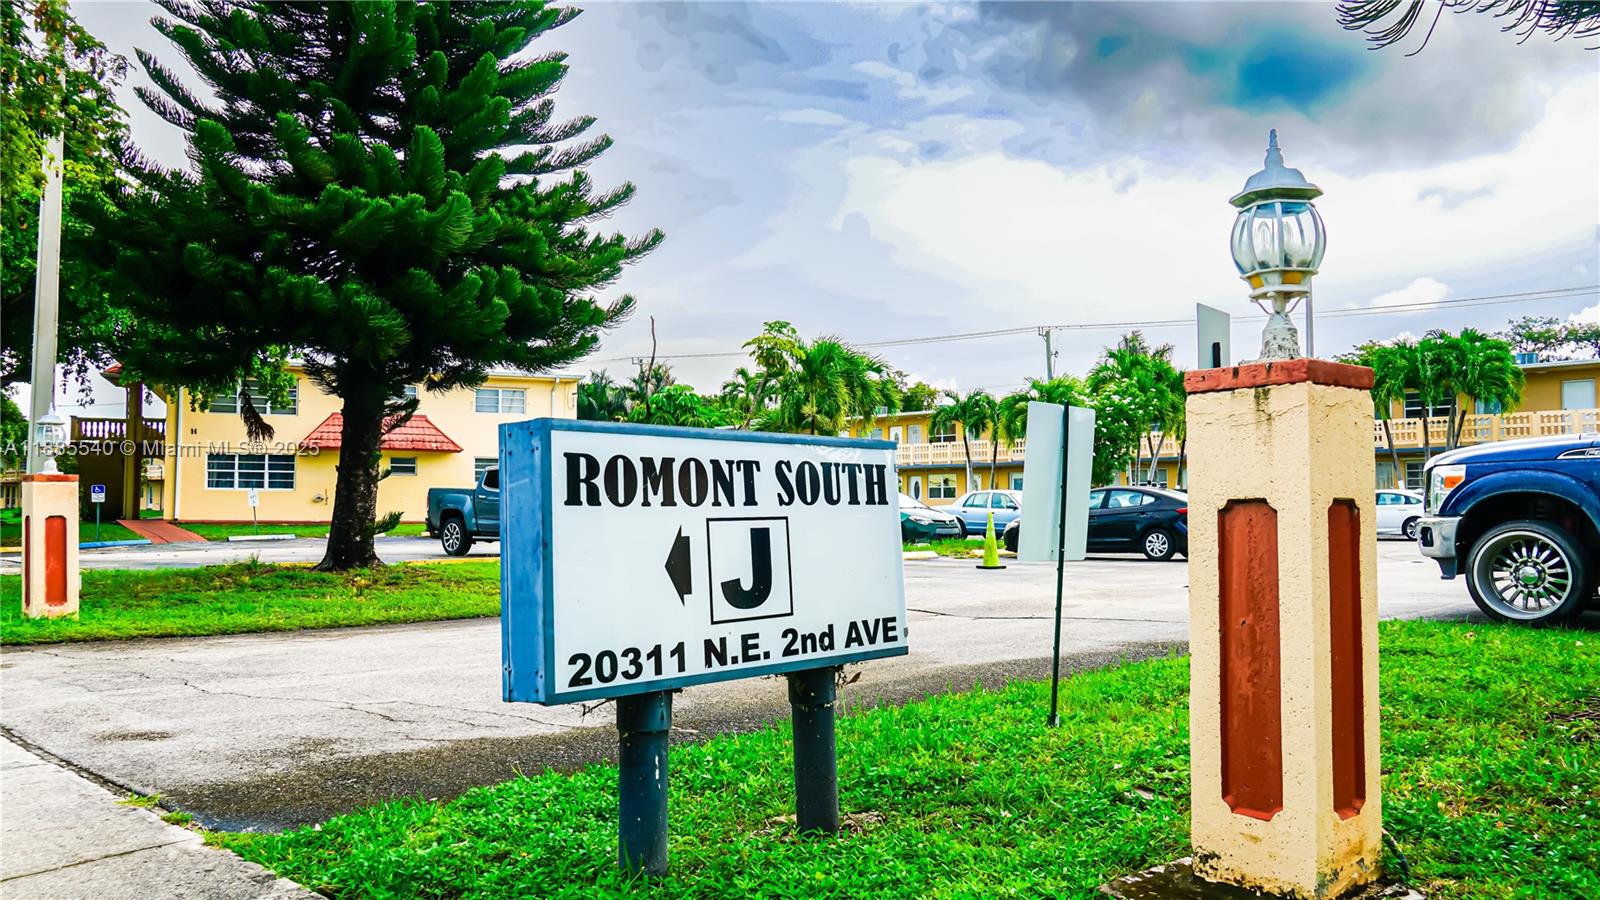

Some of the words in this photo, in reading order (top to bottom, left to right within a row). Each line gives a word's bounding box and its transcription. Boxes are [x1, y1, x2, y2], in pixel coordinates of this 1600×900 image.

[563, 451, 761, 508] ROMONT
[774, 459, 889, 507] SOUTH
[720, 527, 773, 610] J
[567, 641, 686, 688] 20311
[703, 632, 771, 669] N.E.
[781, 623, 835, 658] 2nd
[844, 616, 899, 649] AVE
